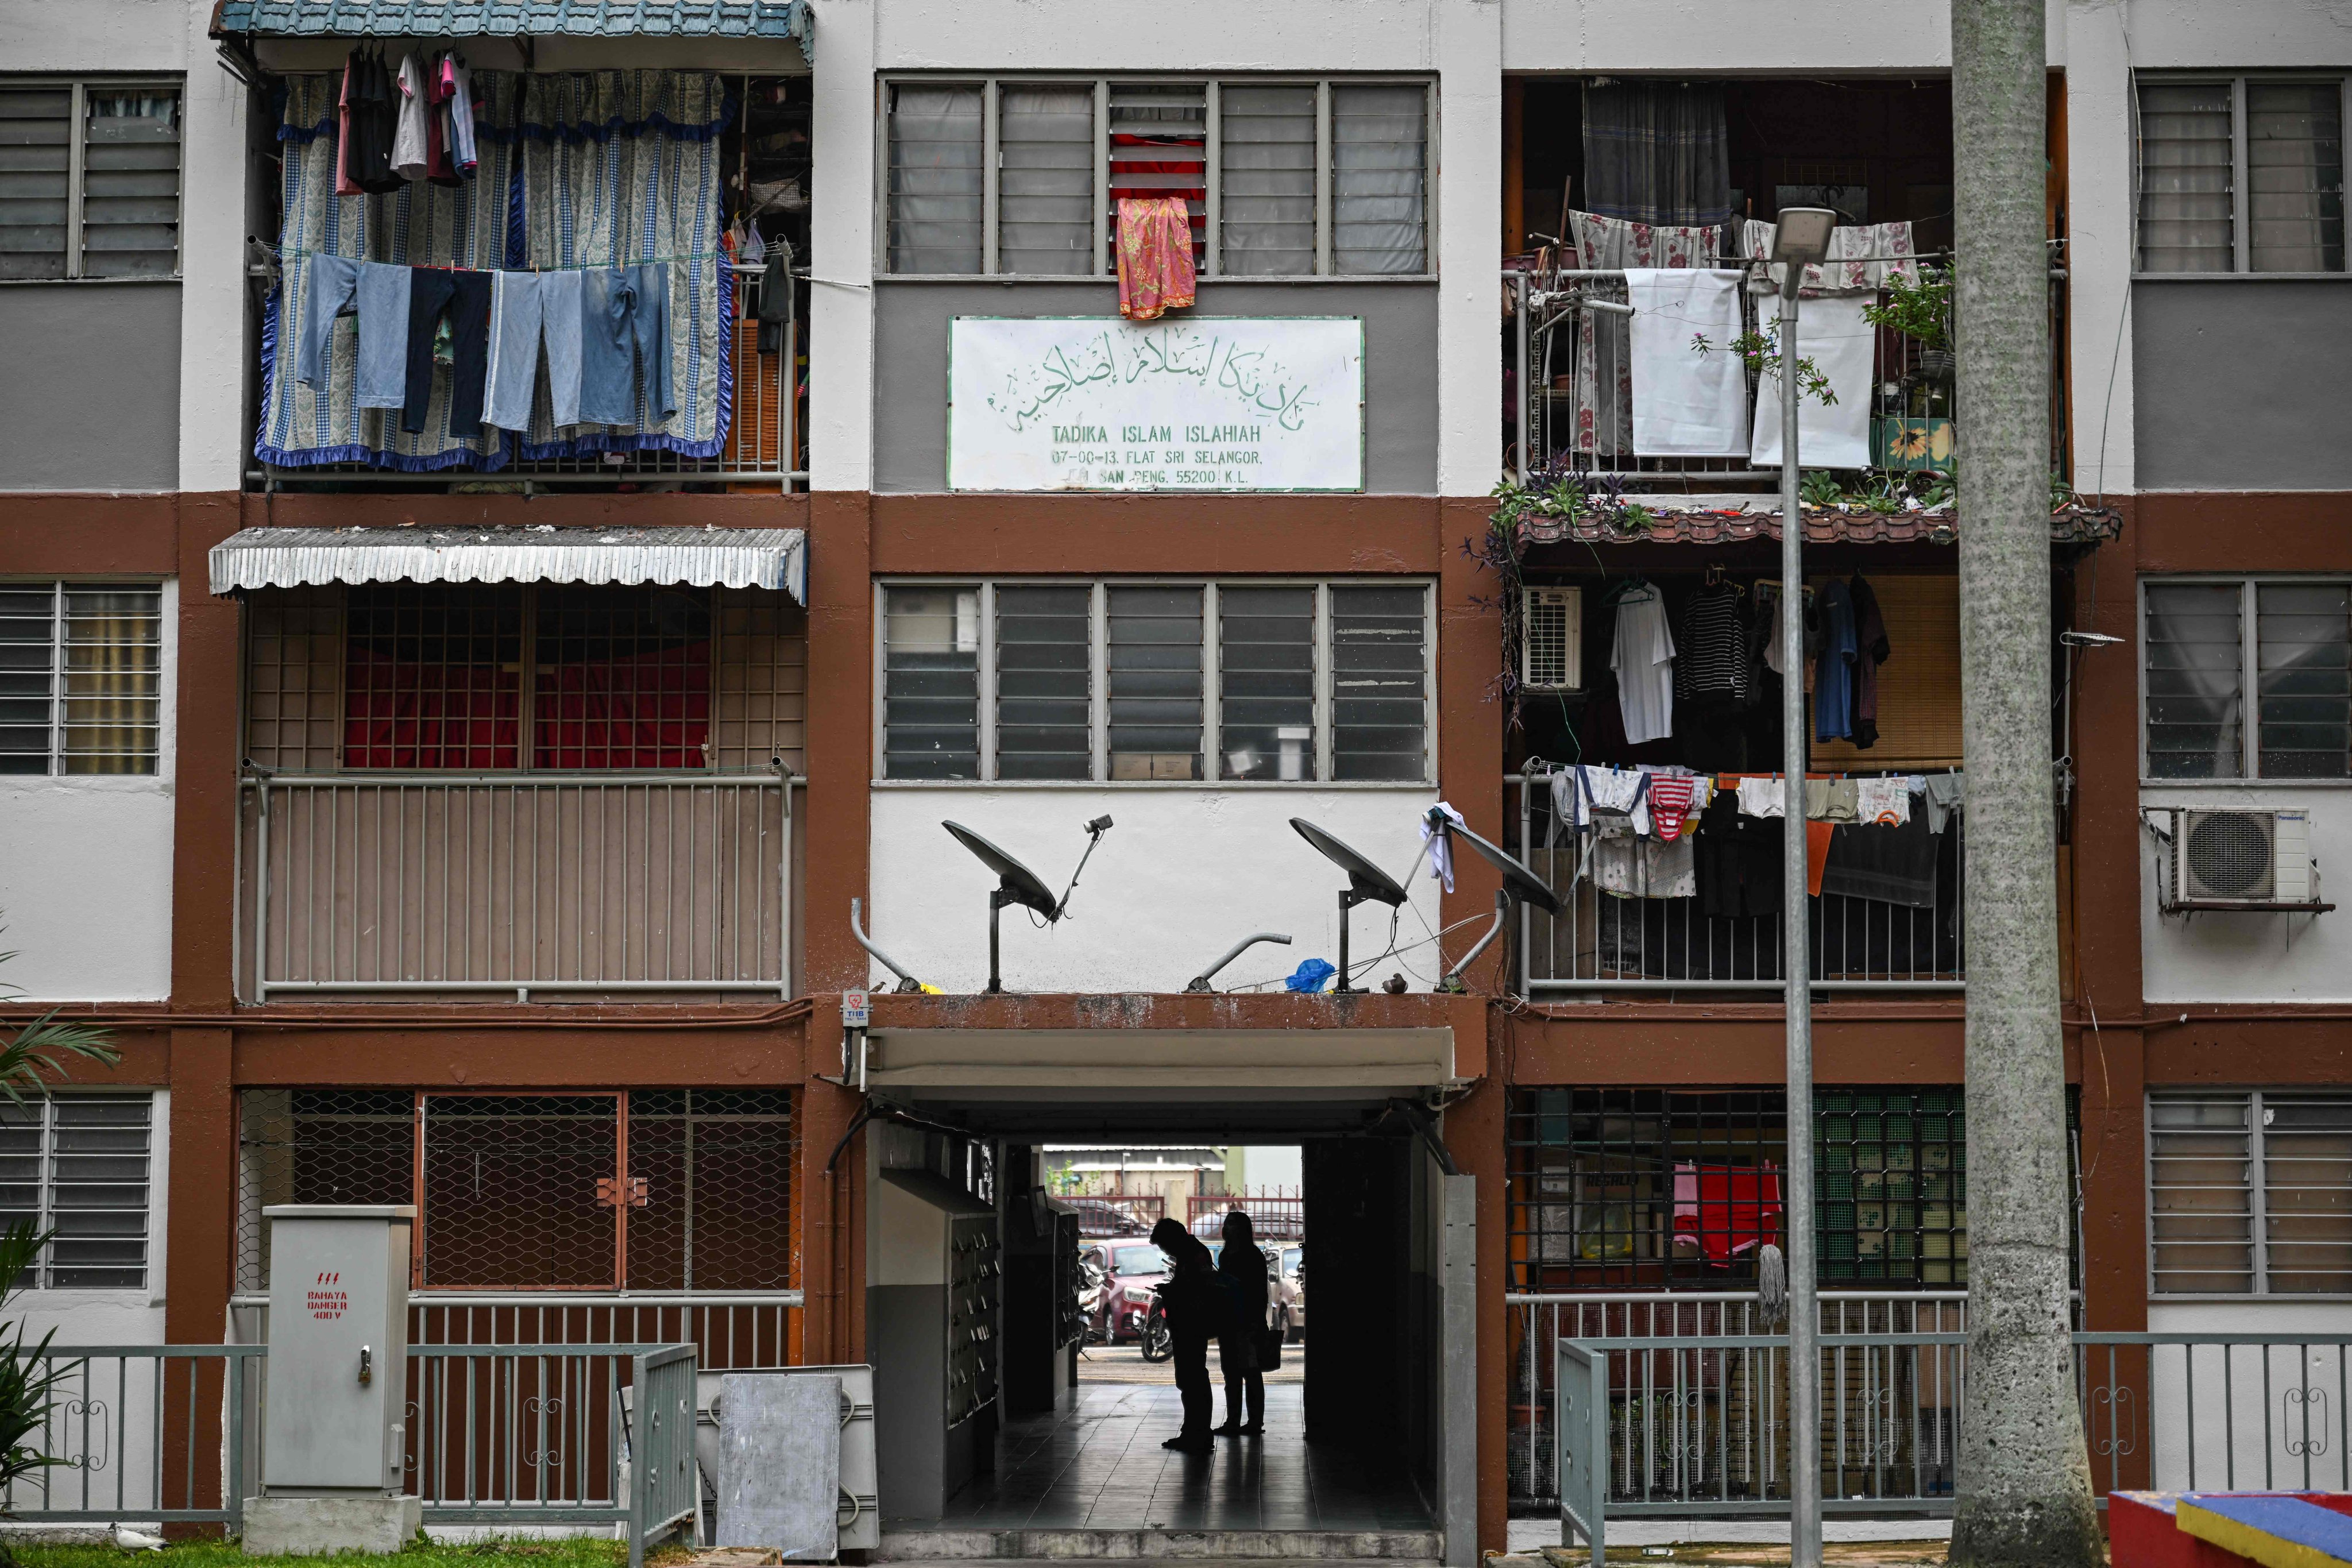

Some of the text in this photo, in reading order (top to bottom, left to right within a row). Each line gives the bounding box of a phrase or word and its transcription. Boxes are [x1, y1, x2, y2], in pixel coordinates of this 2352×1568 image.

[1052, 425, 1260, 442] TADIKA ISLAM ISLAHIAH
[1126, 451, 1155, 464] FLAT
[1165, 451, 1184, 464] SRI
[1195, 450, 1262, 465] SELANGOR,
[1176, 470, 1215, 483] 55200
[1225, 470, 1248, 483] K.L.
[308, 1291, 347, 1299] BAHAYA
[307, 1301, 347, 1310] DANGER
[313, 1311, 332, 1319] 400
